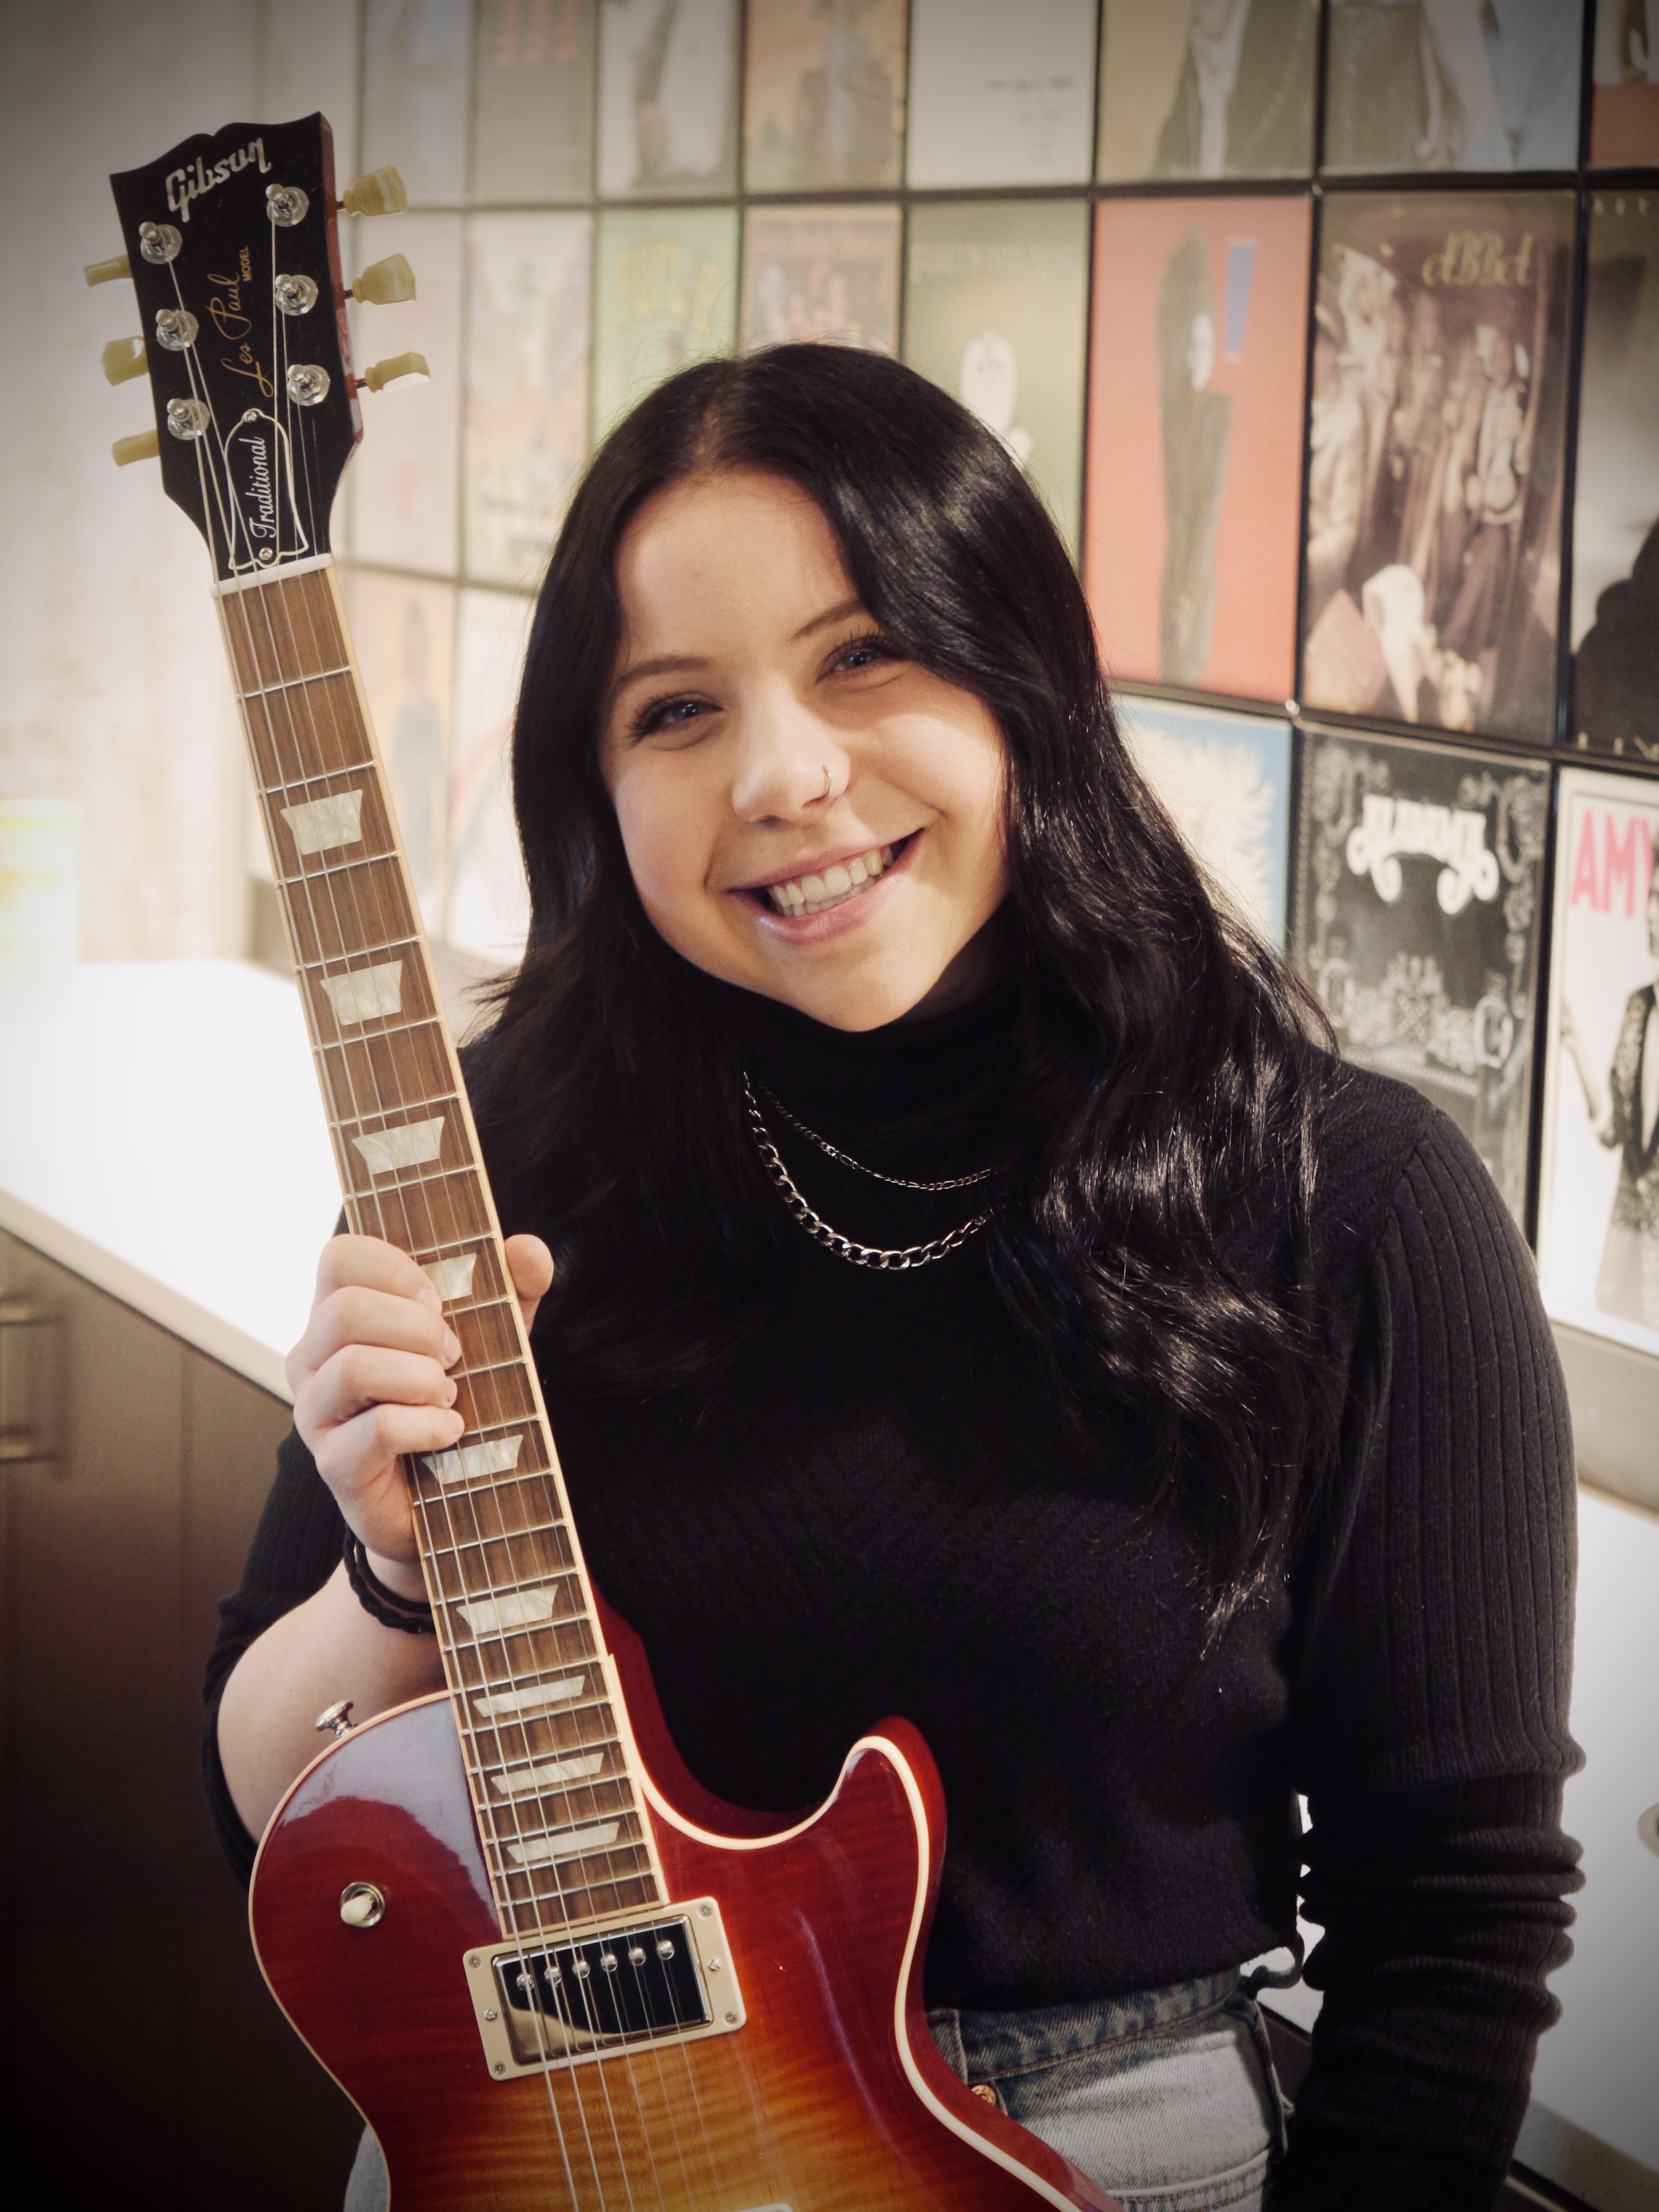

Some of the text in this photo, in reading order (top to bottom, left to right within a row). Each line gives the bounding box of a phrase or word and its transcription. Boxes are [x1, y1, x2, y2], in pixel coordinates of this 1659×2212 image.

[165, 136, 272, 223] Gibson
[238, 246, 253, 282] MODEL
[206, 272, 274, 398] Les Paul
[238, 436, 276, 538] Traditional
